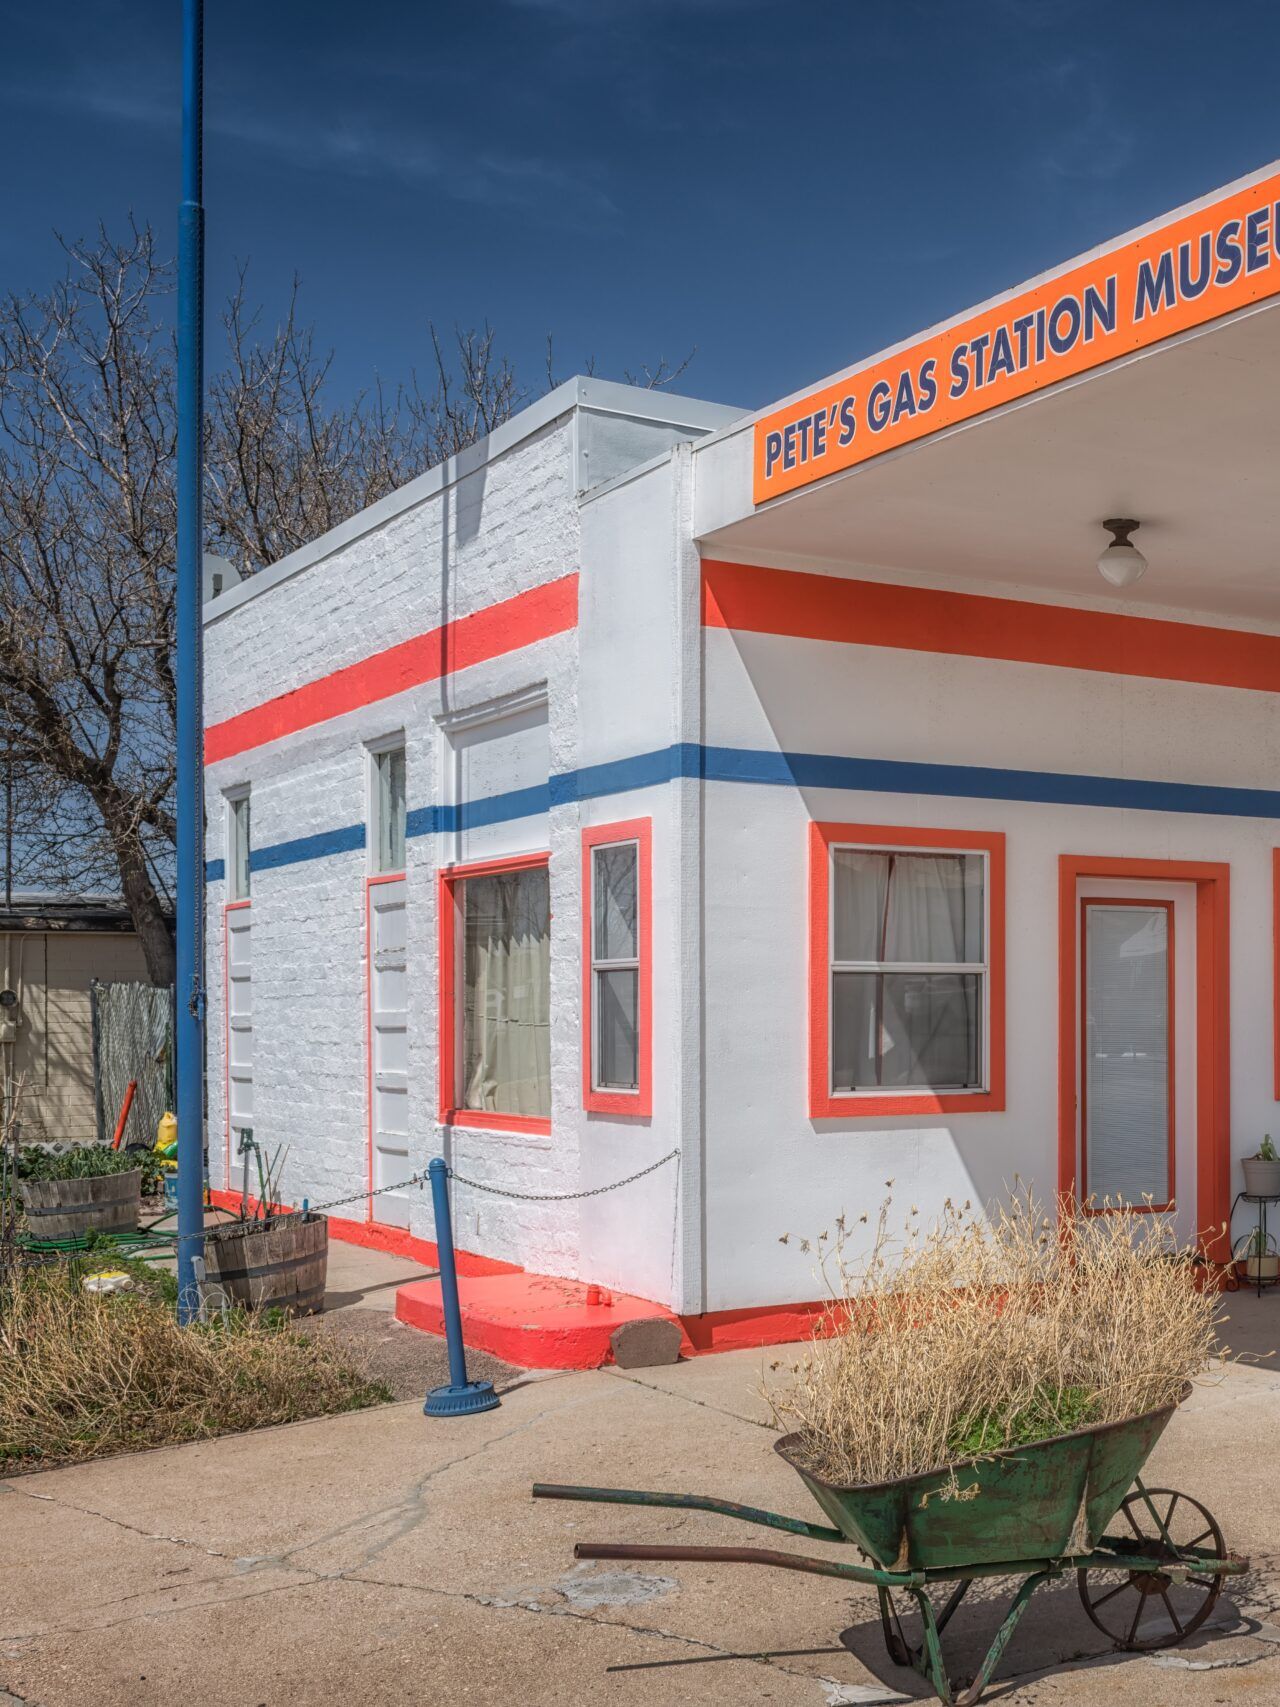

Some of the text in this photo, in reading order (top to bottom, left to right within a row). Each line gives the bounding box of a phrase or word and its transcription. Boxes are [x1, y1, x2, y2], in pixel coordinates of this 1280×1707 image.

[765, 396, 857, 477] PETE'S
[867, 359, 937, 431] GAS
[950, 276, 1117, 398] STATION
